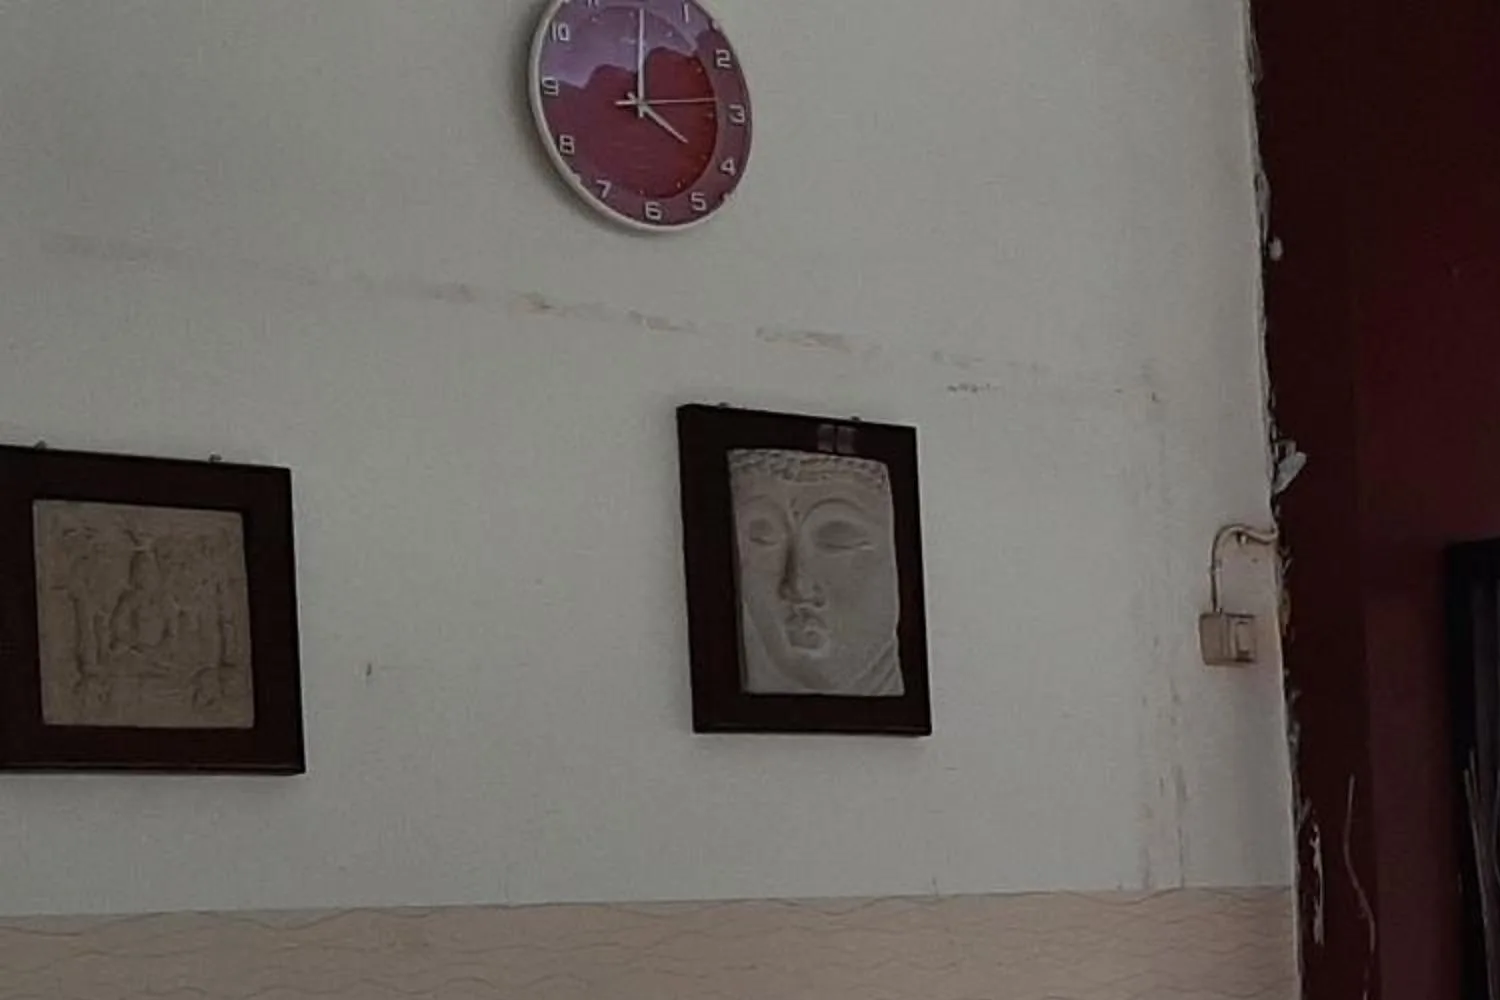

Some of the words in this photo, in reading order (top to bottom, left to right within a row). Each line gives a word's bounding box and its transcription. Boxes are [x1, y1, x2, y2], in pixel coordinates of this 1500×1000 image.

[683, 3, 690, 24] 1
[551, 23, 570, 42] 10
[715, 49, 732, 68] 2
[542, 76, 559, 96] 9
[730, 104, 745, 124] 3
[559, 134, 575, 155] 8
[720, 158, 736, 176] 4
[596, 179, 612, 199] 7
[690, 192, 707, 211] 5
[645, 202, 662, 221] 6
